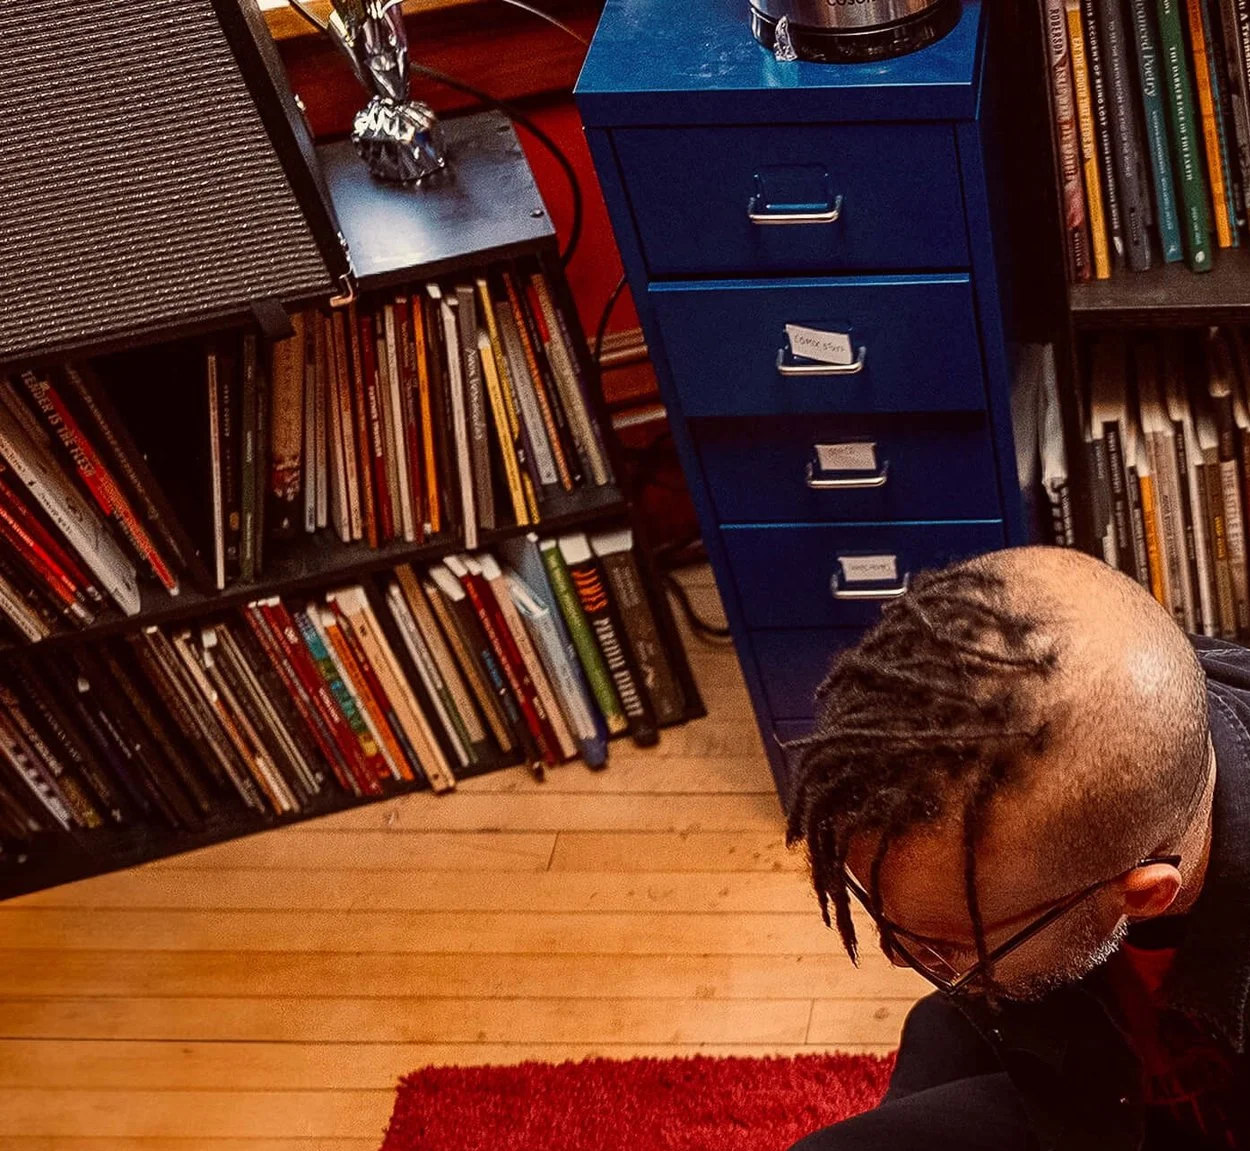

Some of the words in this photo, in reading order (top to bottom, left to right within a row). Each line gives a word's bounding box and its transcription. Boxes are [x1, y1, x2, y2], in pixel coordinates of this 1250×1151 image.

[1084, 0, 1093, 16] HIS
[1238, 12, 1248, 21] A
[1048, 7, 1064, 56] ROBERSON
[1087, 18, 1099, 62] ACCIDENT
[1168, 45, 1178, 63] THE
[1092, 64, 1100, 76] OF
[1139, 53, 1159, 98] Poetry
[1170, 65, 1183, 100] DARKER
[1074, 69, 1087, 97] MOUTH
[1094, 78, 1104, 104] BEING
[1097, 105, 1107, 126] LOST
[1175, 101, 1185, 122] FACE
[1177, 122, 1187, 134] OF
[1179, 134, 1189, 151] THE
[1181, 152, 1193, 181] EARTH
[16, 368, 57, 414] TENDER
[46, 410, 64, 428] IS
[54, 423, 77, 448] THE
[67, 443, 99, 479] FLESH
